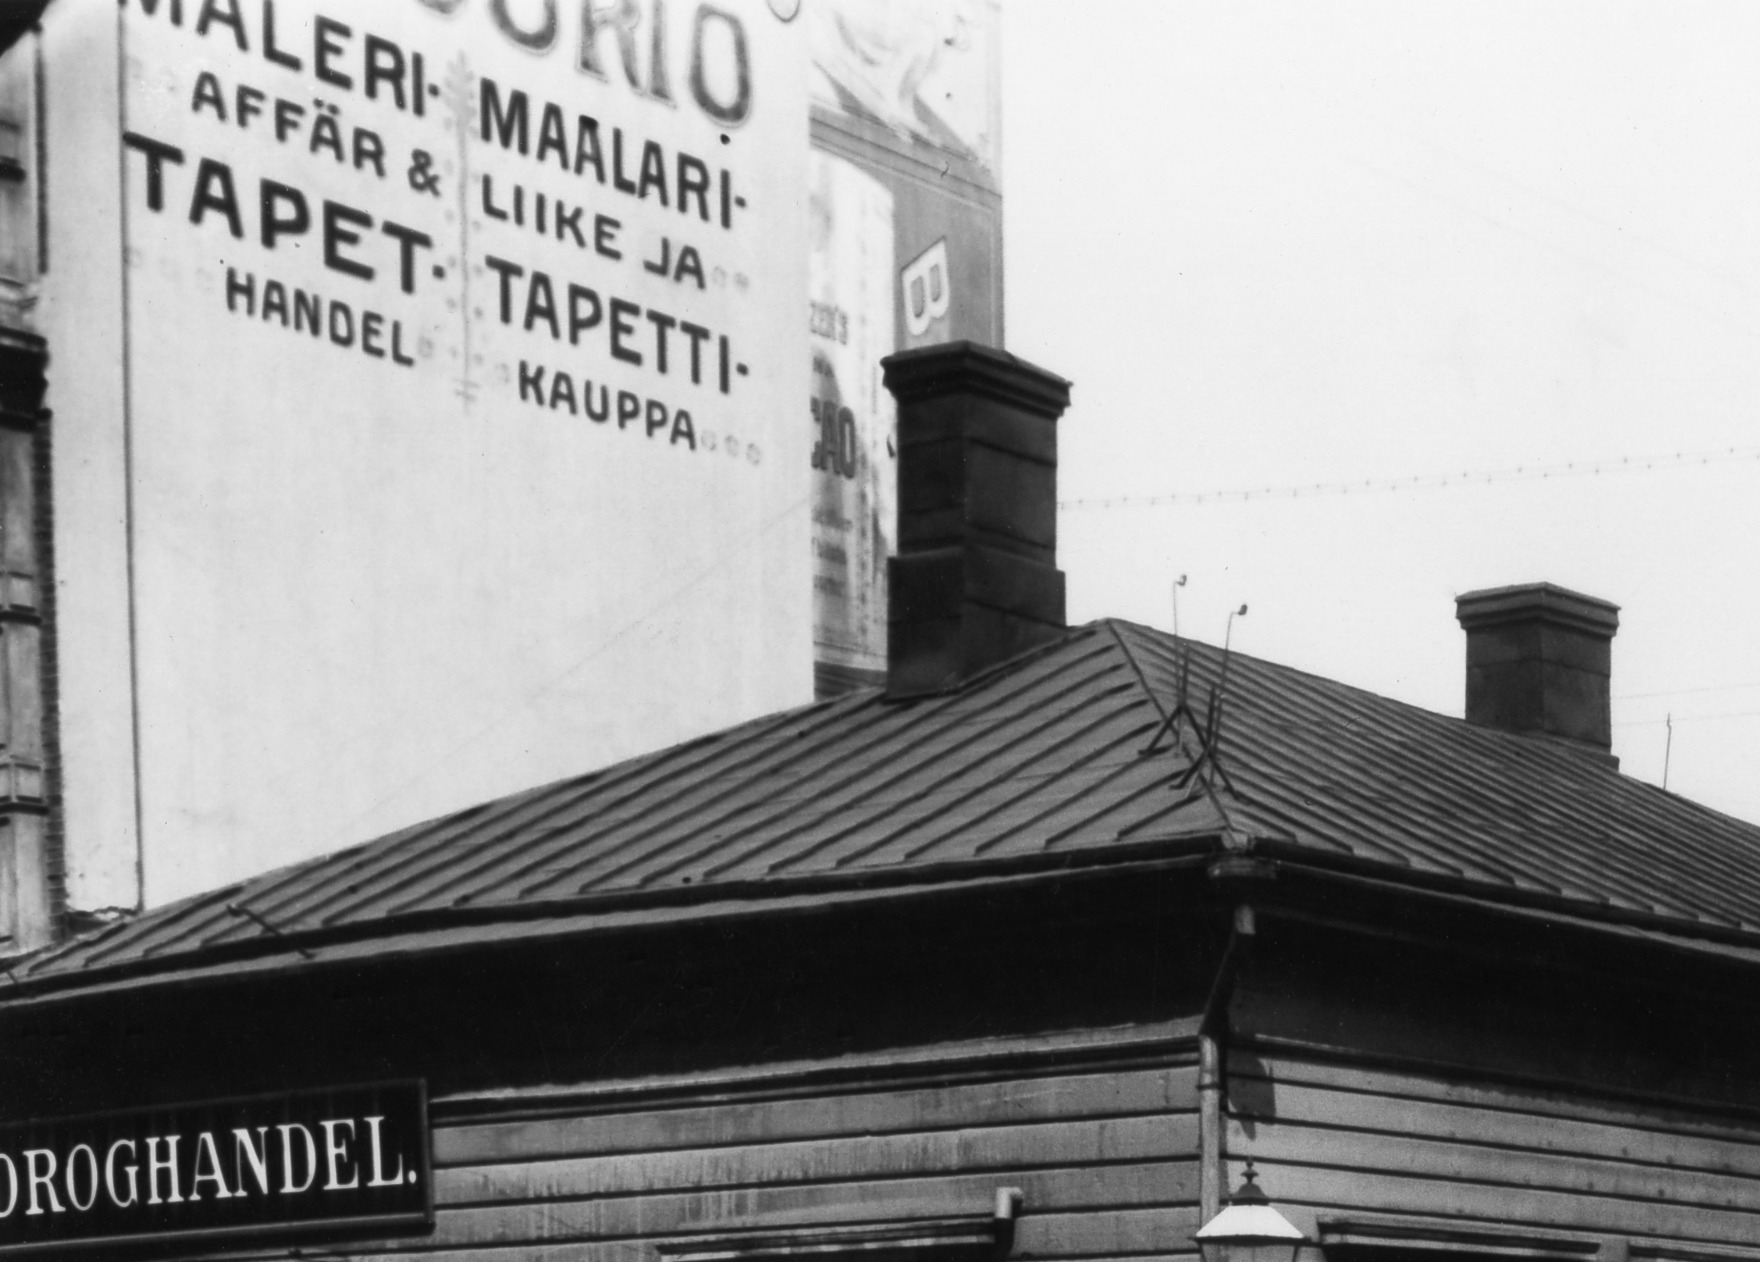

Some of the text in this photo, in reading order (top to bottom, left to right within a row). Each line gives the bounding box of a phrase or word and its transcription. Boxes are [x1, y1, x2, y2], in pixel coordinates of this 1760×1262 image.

[119, 0, 440, 117] ALERI-
[191, 71, 441, 197] AFFÄR &
[481, 173, 706, 290] LIIKE JA
[226, 266, 415, 367] HANDEL
[518, 360, 697, 451] KAUPPA
